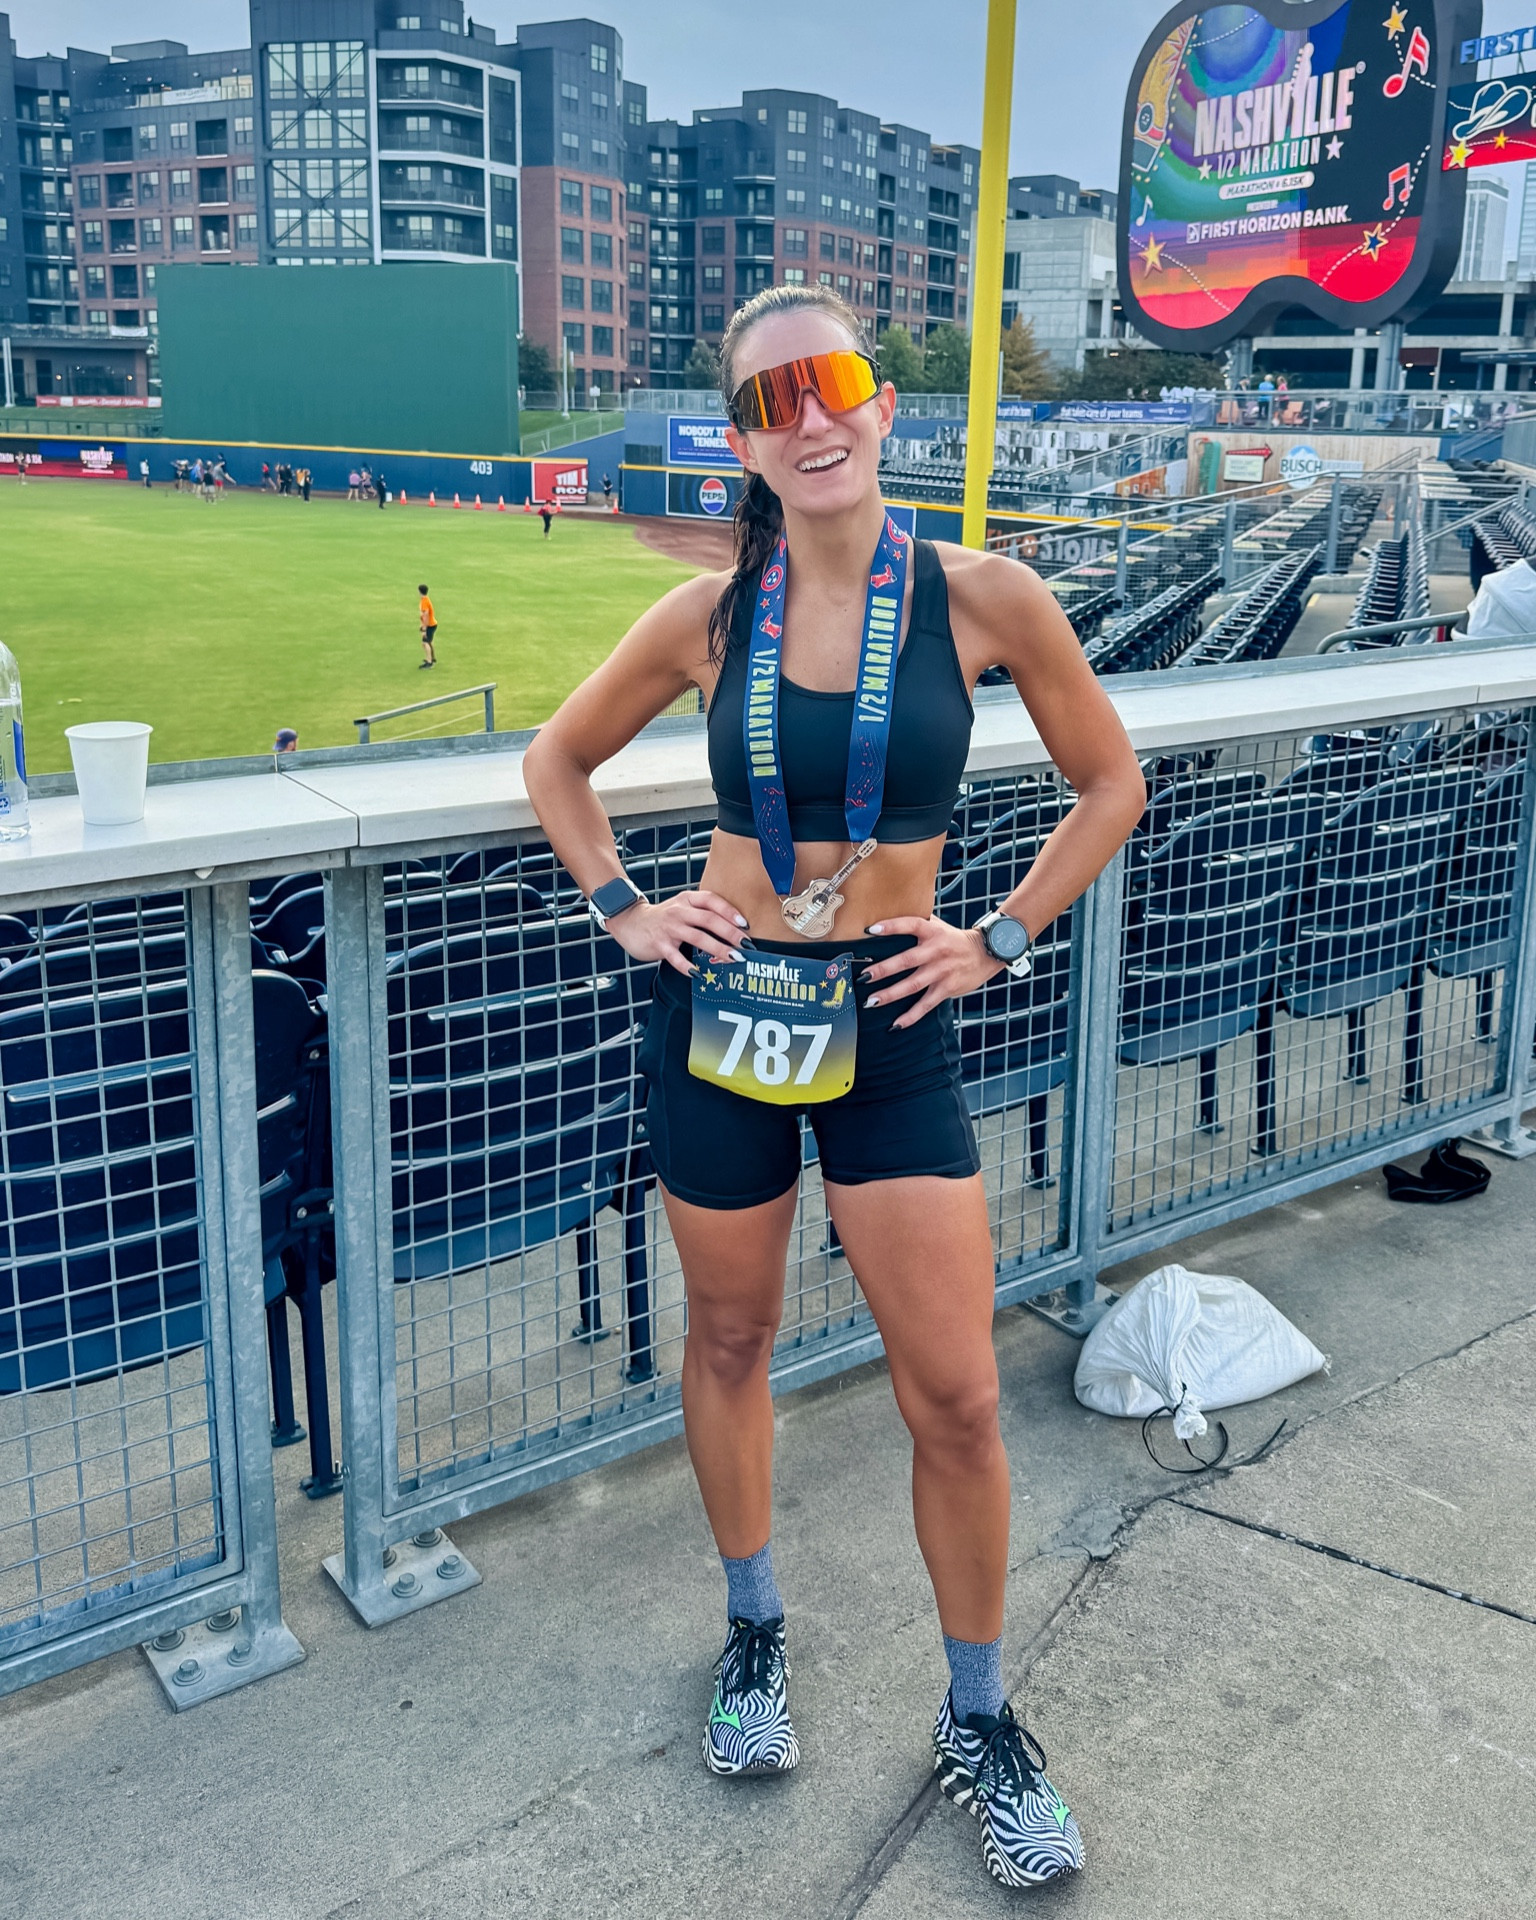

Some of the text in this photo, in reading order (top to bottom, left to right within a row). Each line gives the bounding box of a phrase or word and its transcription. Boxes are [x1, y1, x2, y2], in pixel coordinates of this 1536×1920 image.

[1460, 28, 1526, 64] FIRST
[1217, 137, 1321, 179] 1/2 MARATHON
[1227, 179, 1275, 197] MARATHON
[1201, 221, 1238, 239] FIRST
[1238, 212, 1301, 235] HORIZON
[1107, 409, 1121, 420] your
[1121, 407, 1143, 418] teams
[678, 425, 715, 437] NOBODY
[470, 460, 492, 475] 403
[1280, 459, 1323, 473] BUSCH
[555, 470, 578, 486] TIM
[701, 491, 725, 501] PEPSI
[858, 595, 898, 722] 1/2 MARATHON
[748, 648, 778, 777] 1/2 MARATHON
[728, 972, 817, 1002] 1/2 MARATHON
[716, 1010, 833, 1085] 787
